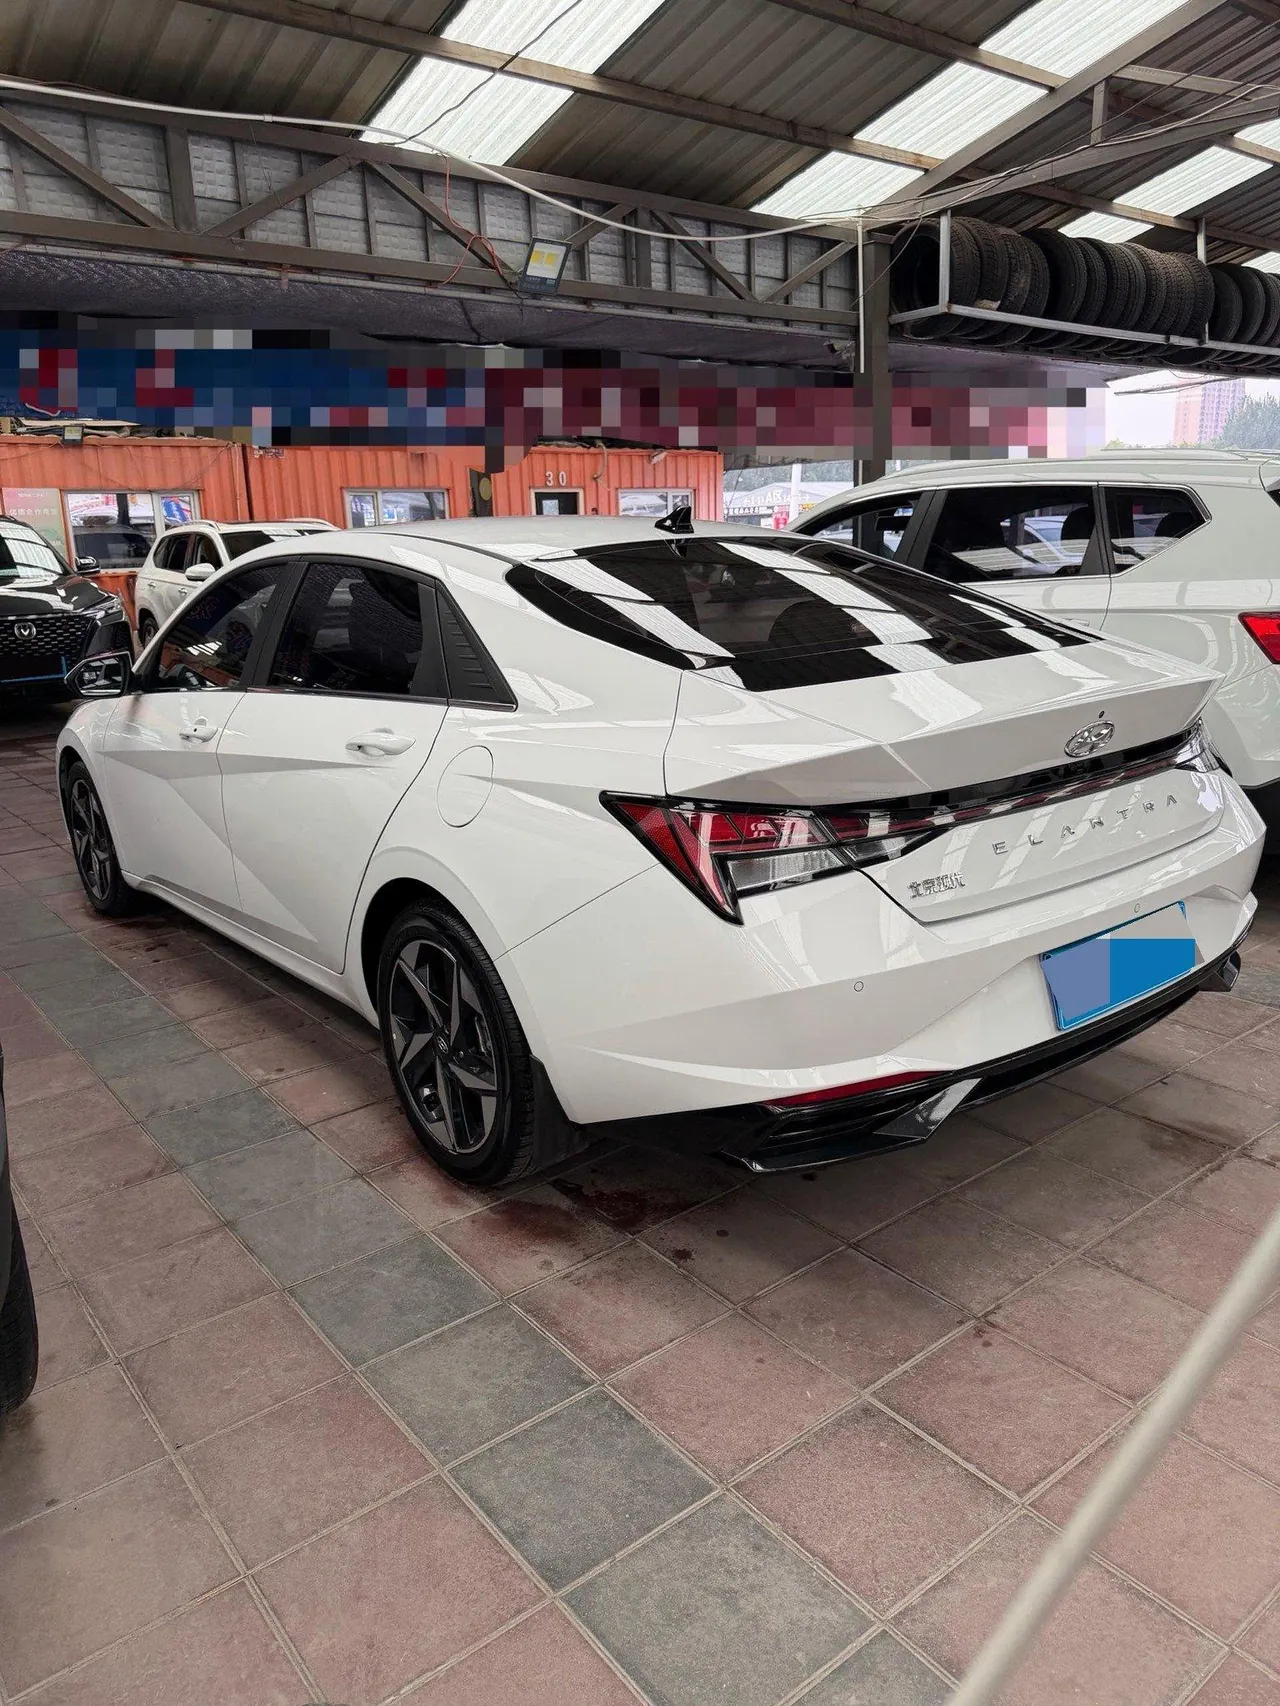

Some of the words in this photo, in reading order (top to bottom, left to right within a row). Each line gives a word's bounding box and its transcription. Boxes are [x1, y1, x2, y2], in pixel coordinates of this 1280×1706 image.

[545, 471, 567, 487] 30
[991, 794, 1178, 855] ELANTRA
[907, 871, 966, 899] 北京现代
